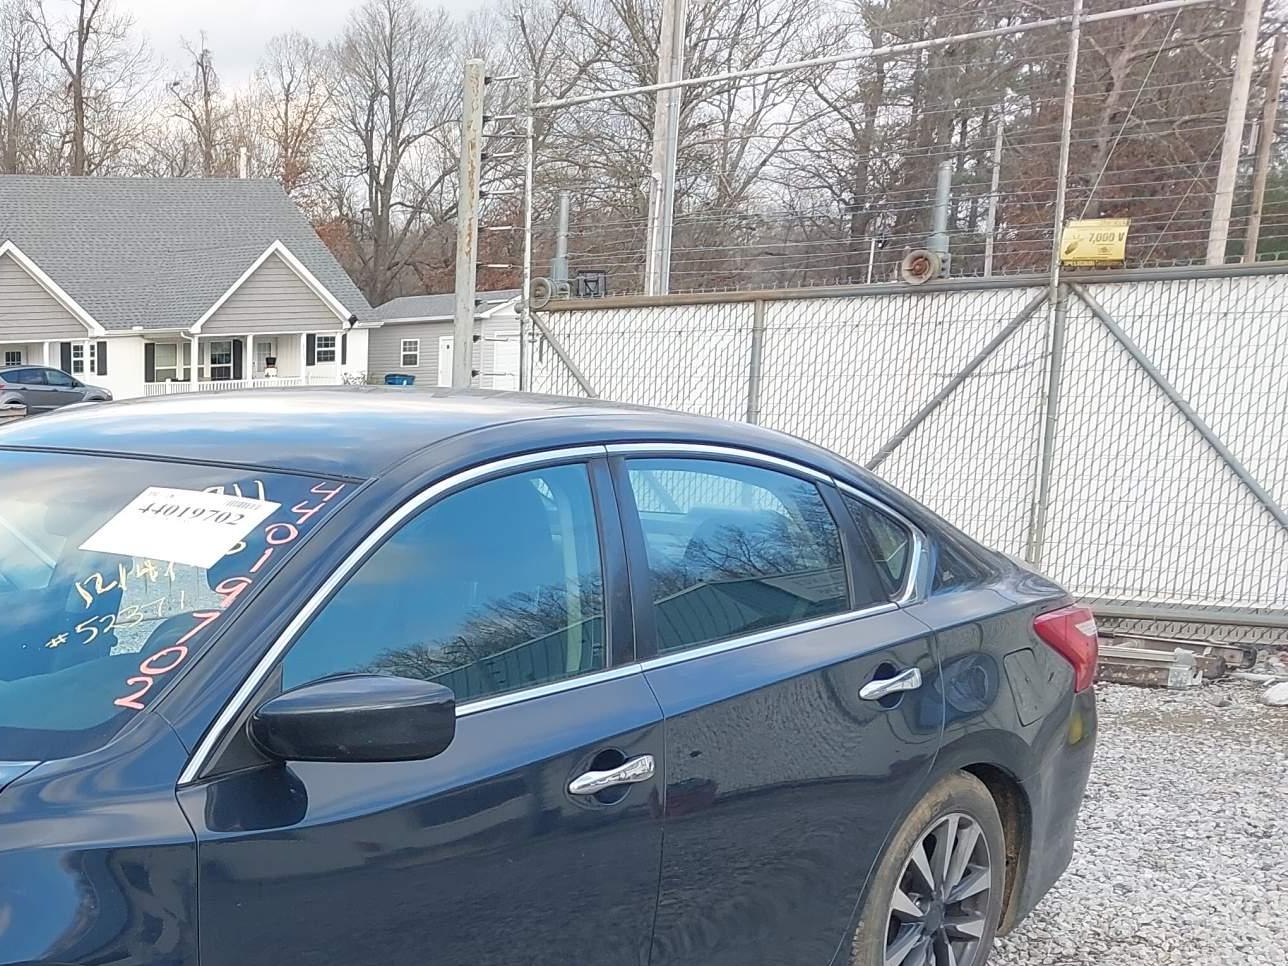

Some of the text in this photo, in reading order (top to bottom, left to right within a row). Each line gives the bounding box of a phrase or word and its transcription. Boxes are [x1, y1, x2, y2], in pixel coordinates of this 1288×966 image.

[1089, 232, 1125, 244] 7,000 V
[138, 502, 246, 526] 44019702
[114, 482, 345, 710] 44019702
